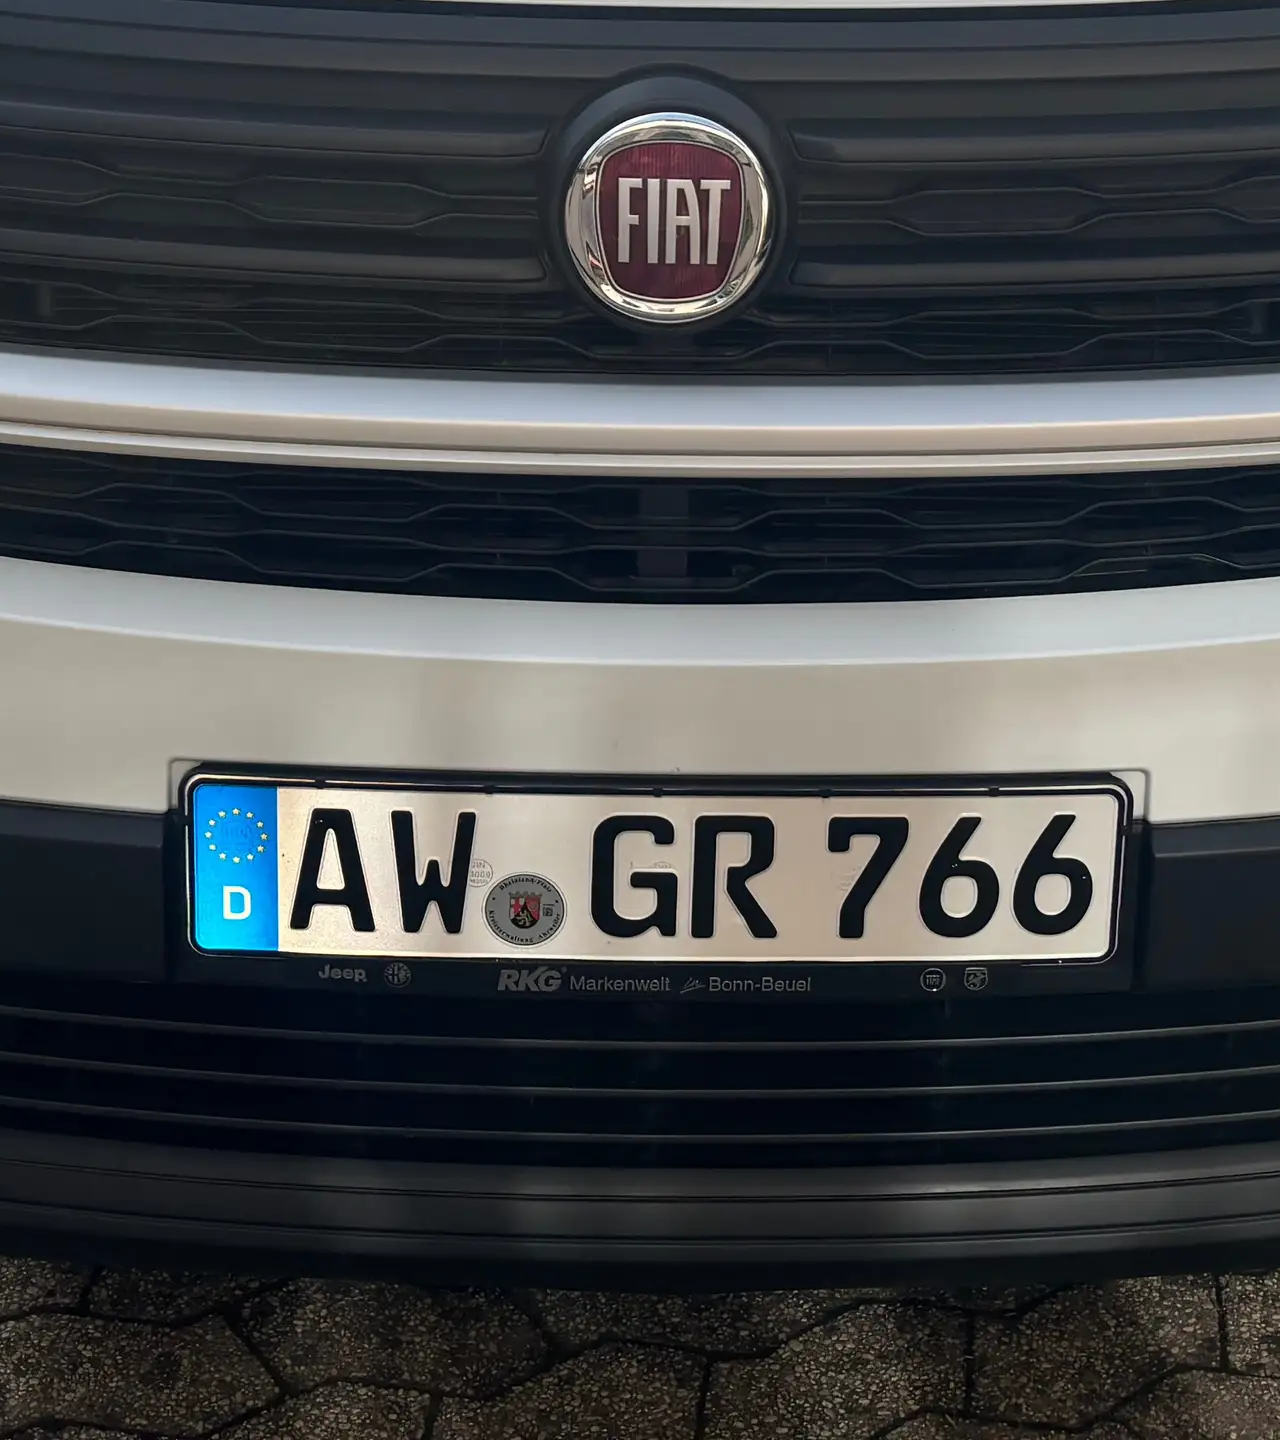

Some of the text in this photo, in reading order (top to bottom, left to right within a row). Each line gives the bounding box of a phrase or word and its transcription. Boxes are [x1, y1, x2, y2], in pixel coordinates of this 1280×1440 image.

[617, 176, 731, 265] FIAT
[290, 807, 1094, 939] AW GR 766
[223, 885, 252, 920] D
[318, 964, 367, 982] Jeep
[497, 966, 562, 992] RKG
[570, 976, 671, 992] Markenwelt
[709, 976, 812, 992] Bonn-Beuel
